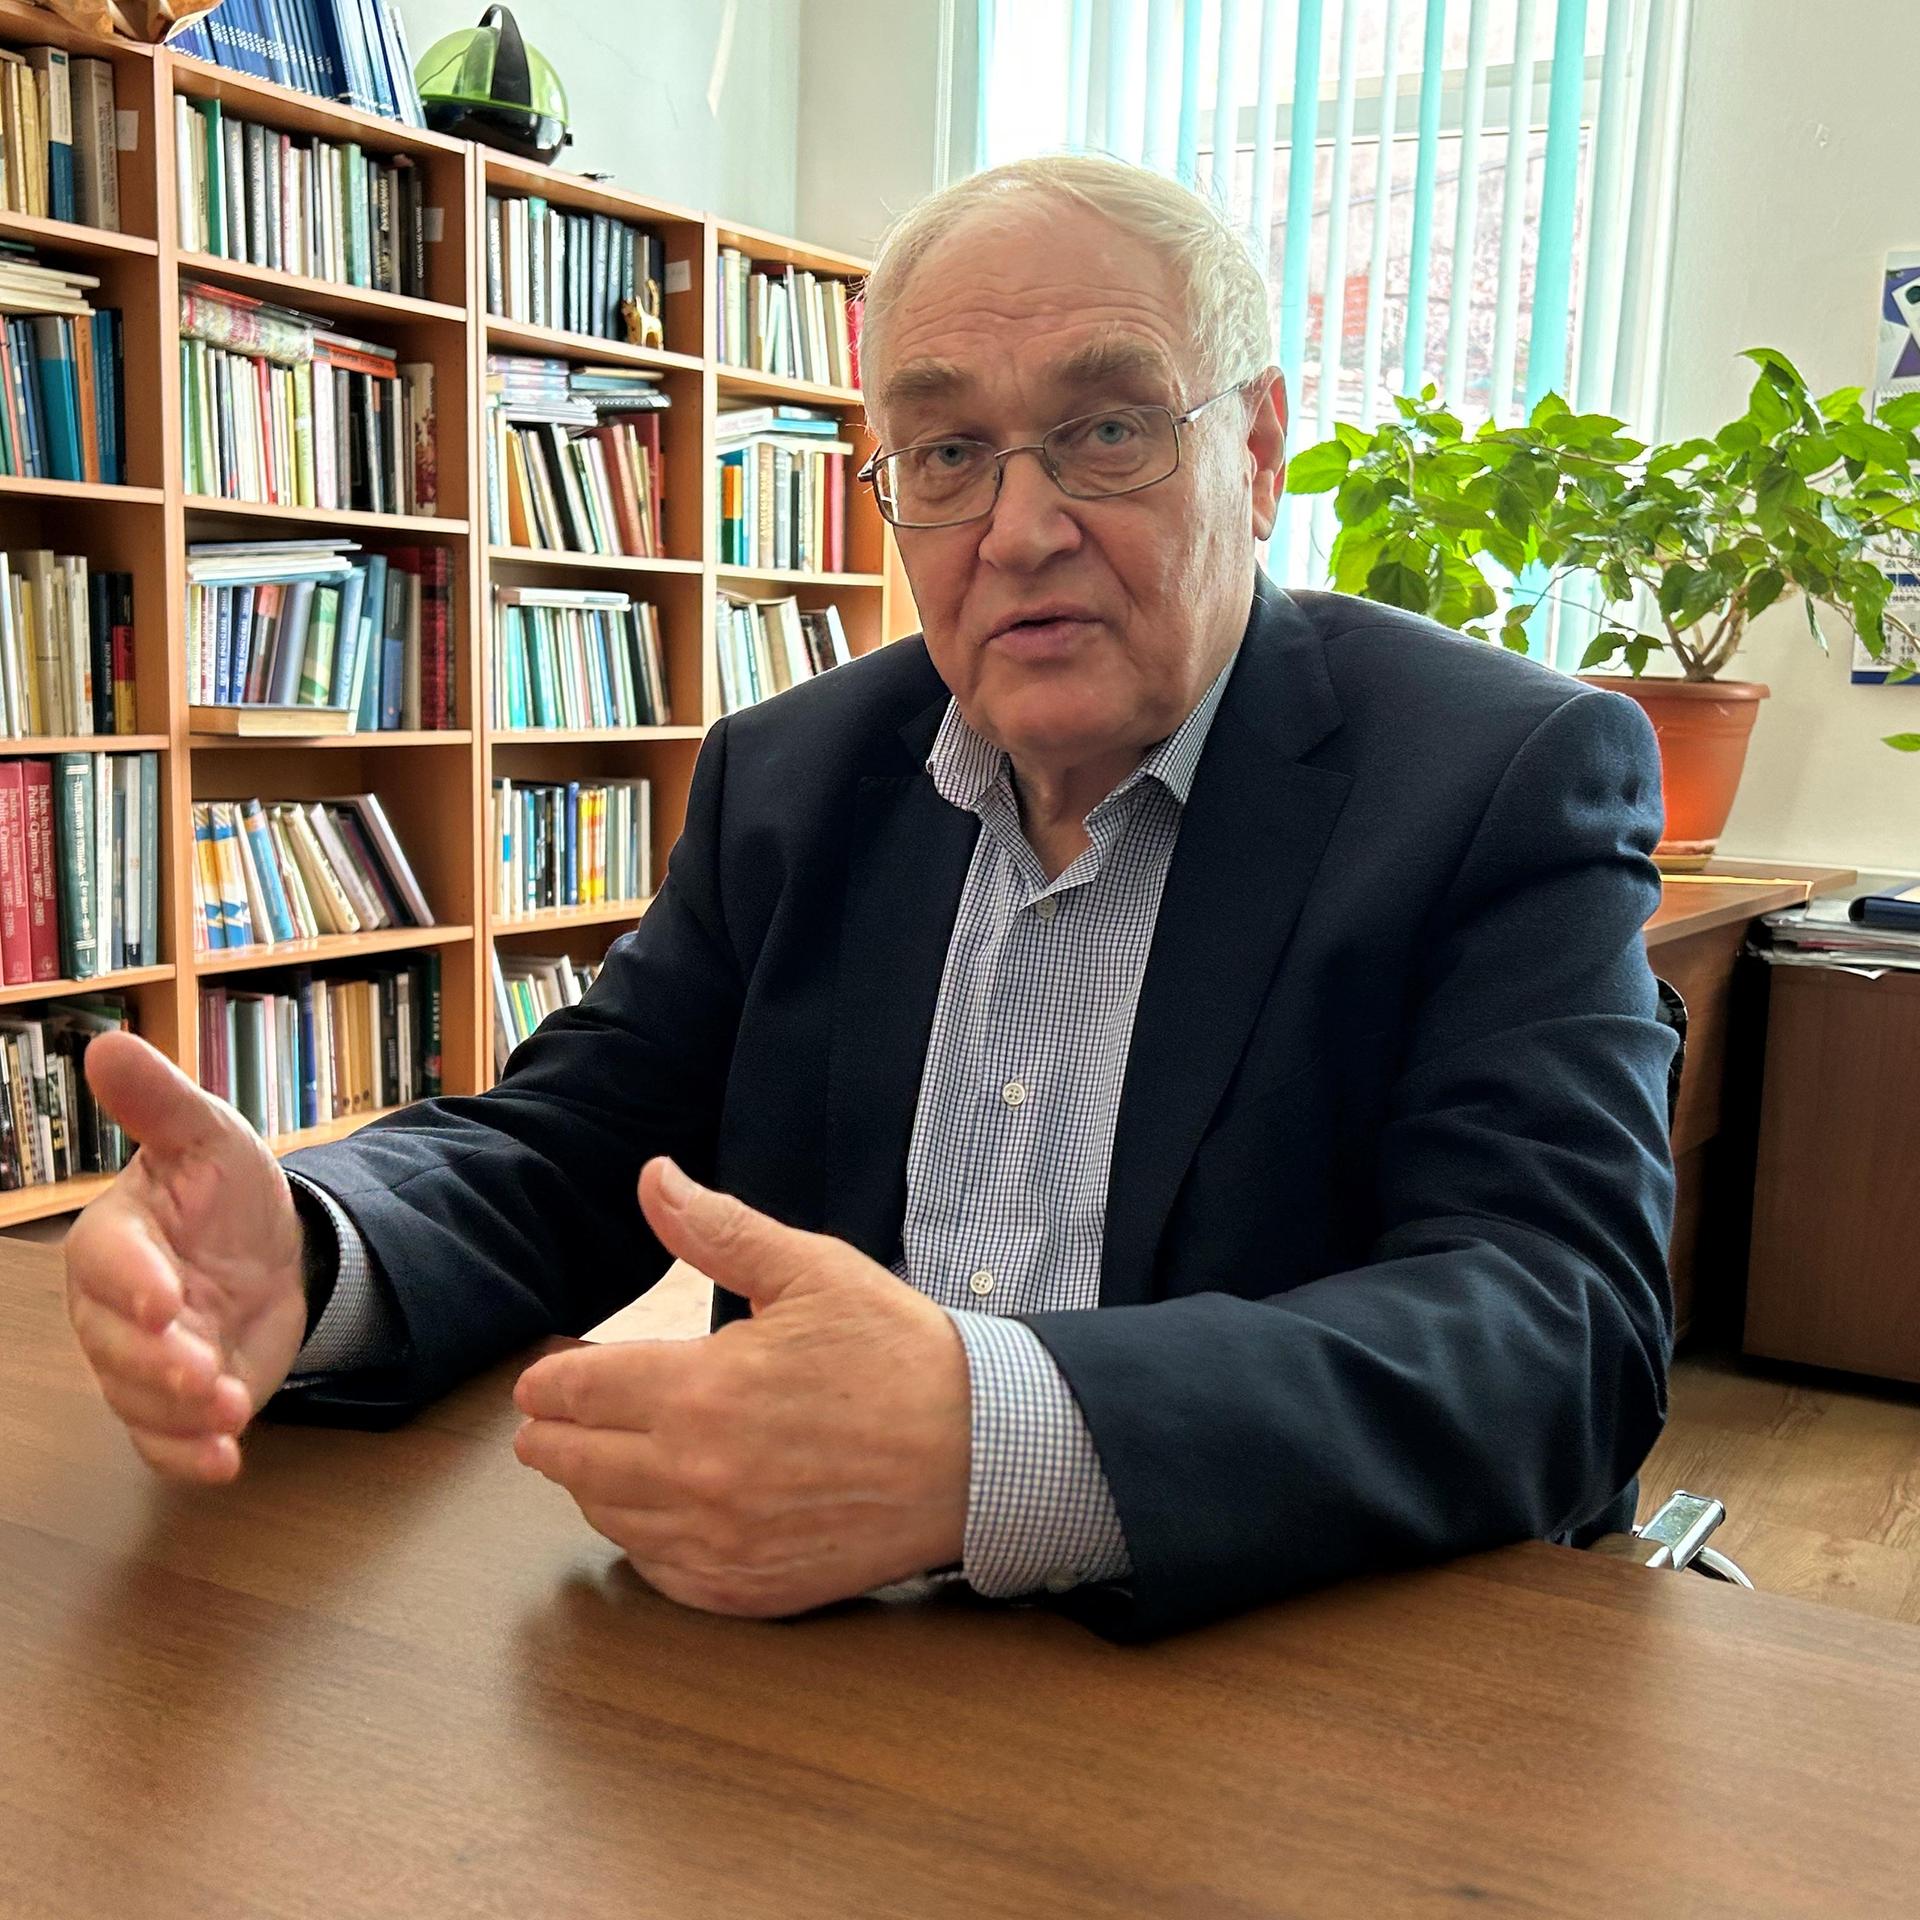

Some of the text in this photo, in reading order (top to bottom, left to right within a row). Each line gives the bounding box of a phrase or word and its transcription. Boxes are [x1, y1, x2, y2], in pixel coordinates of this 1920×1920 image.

[0, 789, 9, 824] Public
[27, 785, 39, 818] Public
[9, 789, 25, 908] Index to International
[39, 785, 55, 900] Index to International
